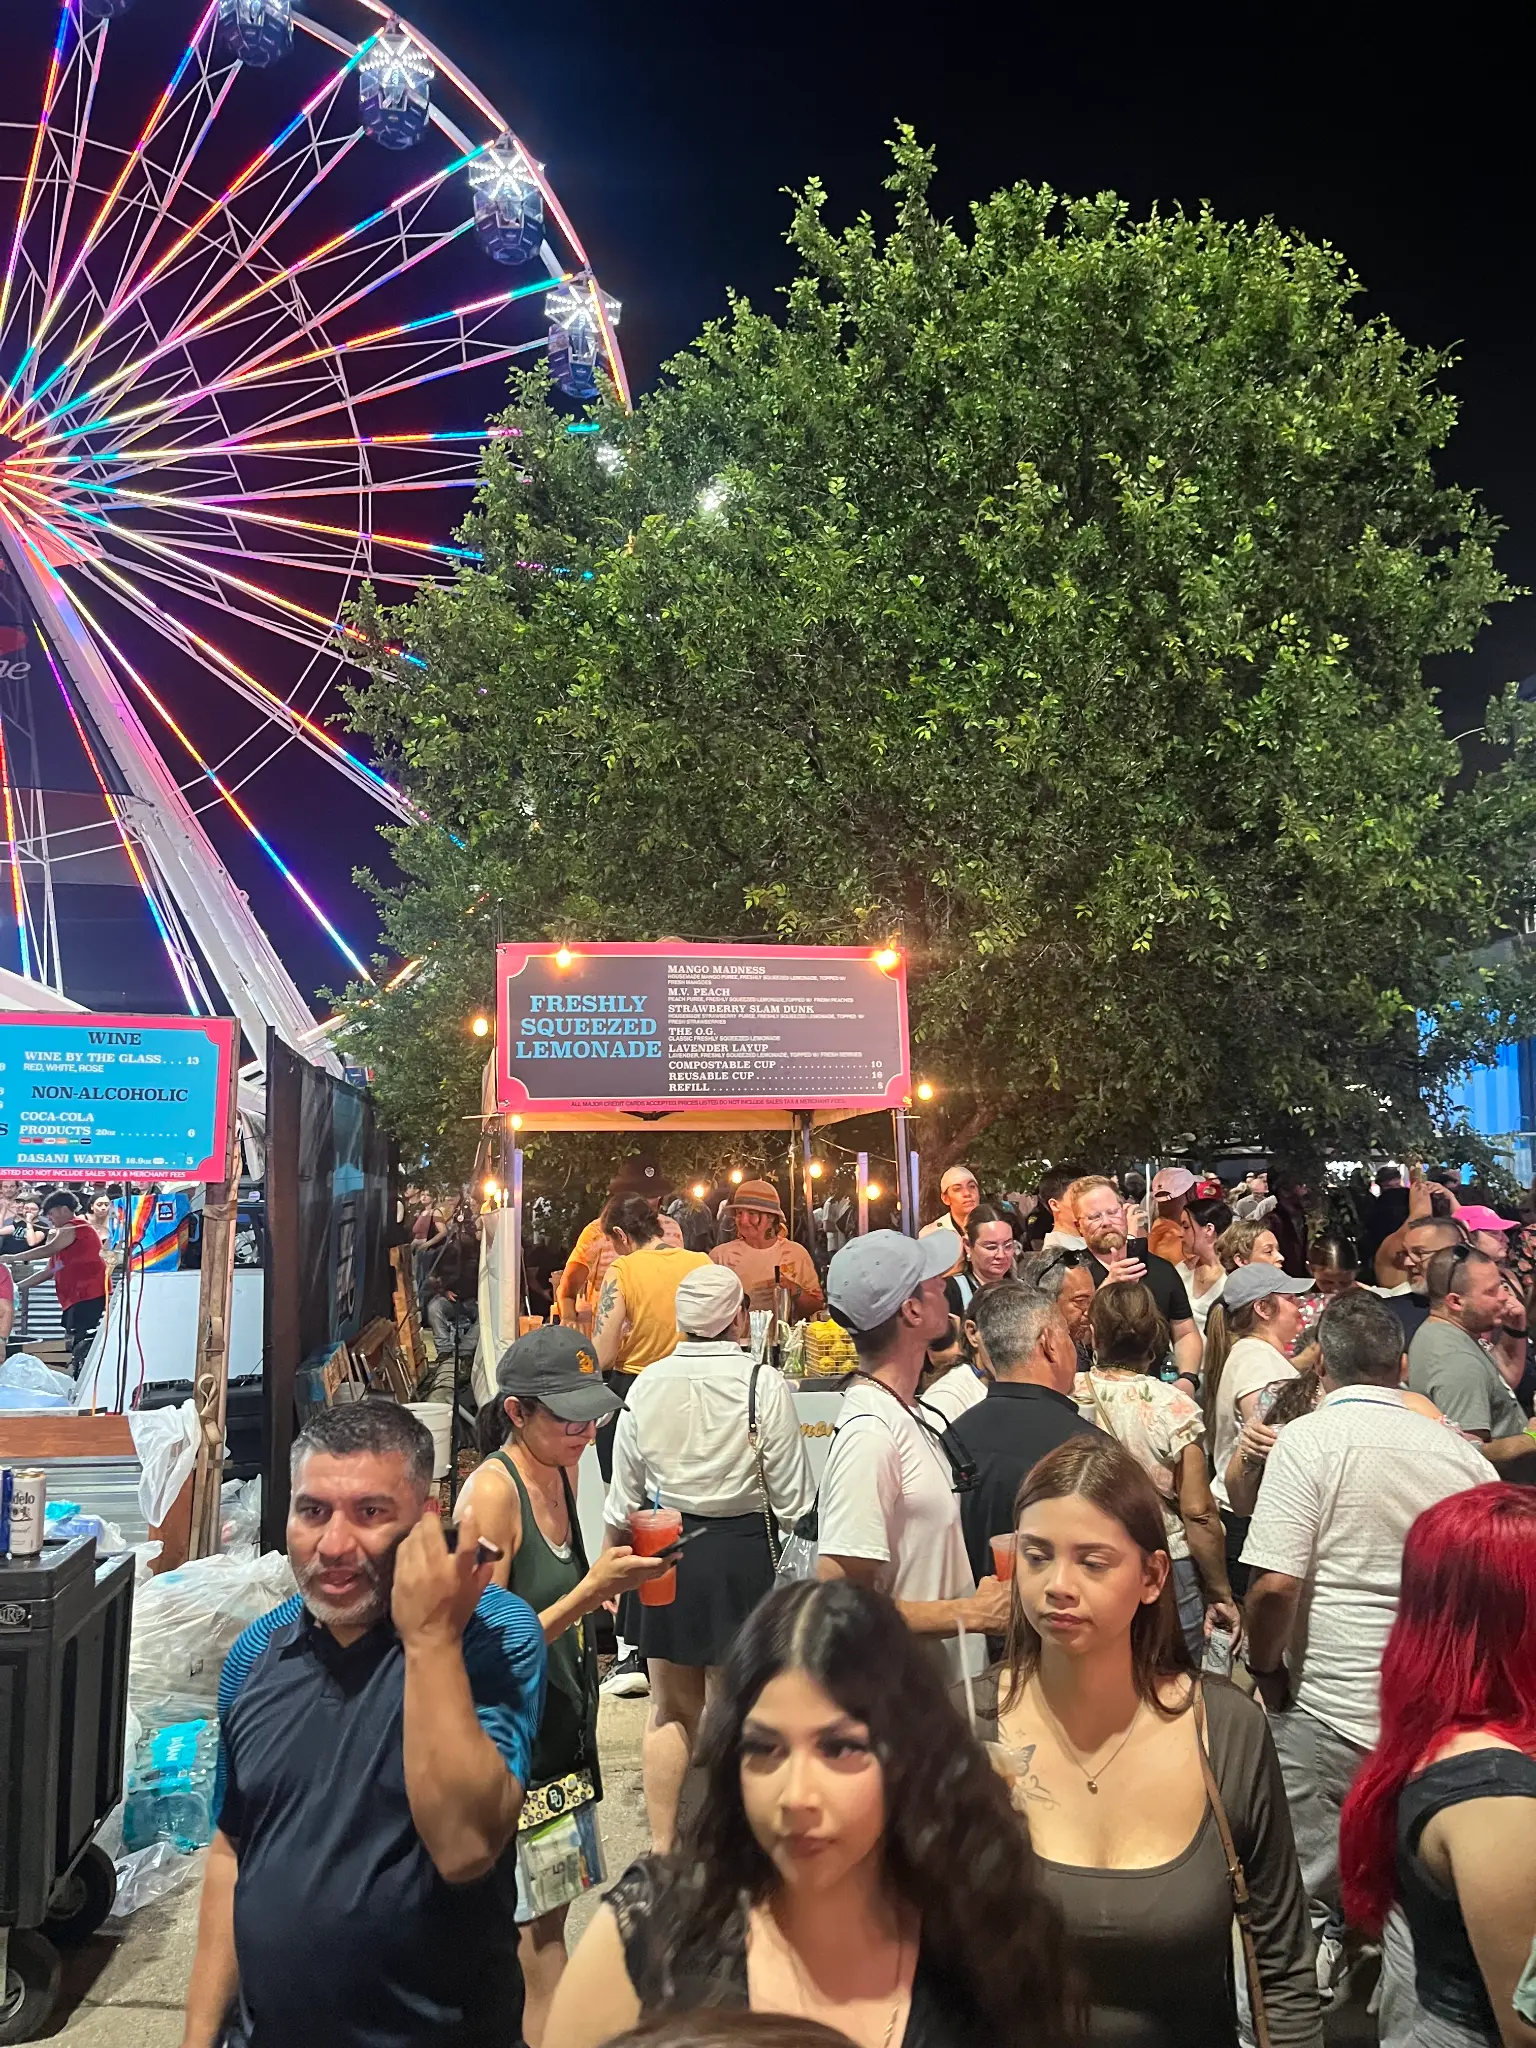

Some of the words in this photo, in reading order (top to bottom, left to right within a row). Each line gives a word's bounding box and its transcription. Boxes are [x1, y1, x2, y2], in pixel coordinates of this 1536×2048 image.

[668, 965, 709, 974] MANGO
[713, 966, 766, 974] MADNESS
[668, 988, 689, 996] M.V.
[694, 988, 730, 996] PEACH
[530, 995, 648, 1013] FRESHLY
[668, 1005, 746, 1013] STRAWBERRY
[749, 1005, 780, 1013] SLAM
[784, 1005, 814, 1013] DUNK
[520, 1018, 657, 1037] SQUEEZED
[88, 1032, 141, 1045] WINE
[516, 1041, 662, 1058] LEMONADE
[668, 1044, 728, 1052] LAVENDER
[732, 1044, 768, 1052] LAYUP
[24, 1051, 62, 1060] WINE
[66, 1052, 83, 1061] BY
[87, 1053, 115, 1062] THE
[119, 1054, 161, 1064] GLASS
[186, 1056, 200, 1065] 13
[24, 1063, 45, 1072] RED,
[46, 1064, 77, 1072] WHITE,
[79, 1064, 104, 1072] ROSE
[669, 1061, 750, 1069] COMPOSTABLE
[871, 1060, 882, 1068] 10
[669, 1072, 728, 1080] REUSABLE
[669, 1083, 710, 1092] REFILL
[31, 1086, 188, 1101] NON-ALCOHOLIC
[20, 1112, 95, 1122] COCA-COLA
[20, 1125, 91, 1135] PRODUCTS
[187, 1128, 195, 1138] 6
[17, 1154, 69, 1163] DASANI
[74, 1154, 120, 1164] WATER
[186, 1156, 194, 1165] 5
[13, 1492, 34, 1504] delo
